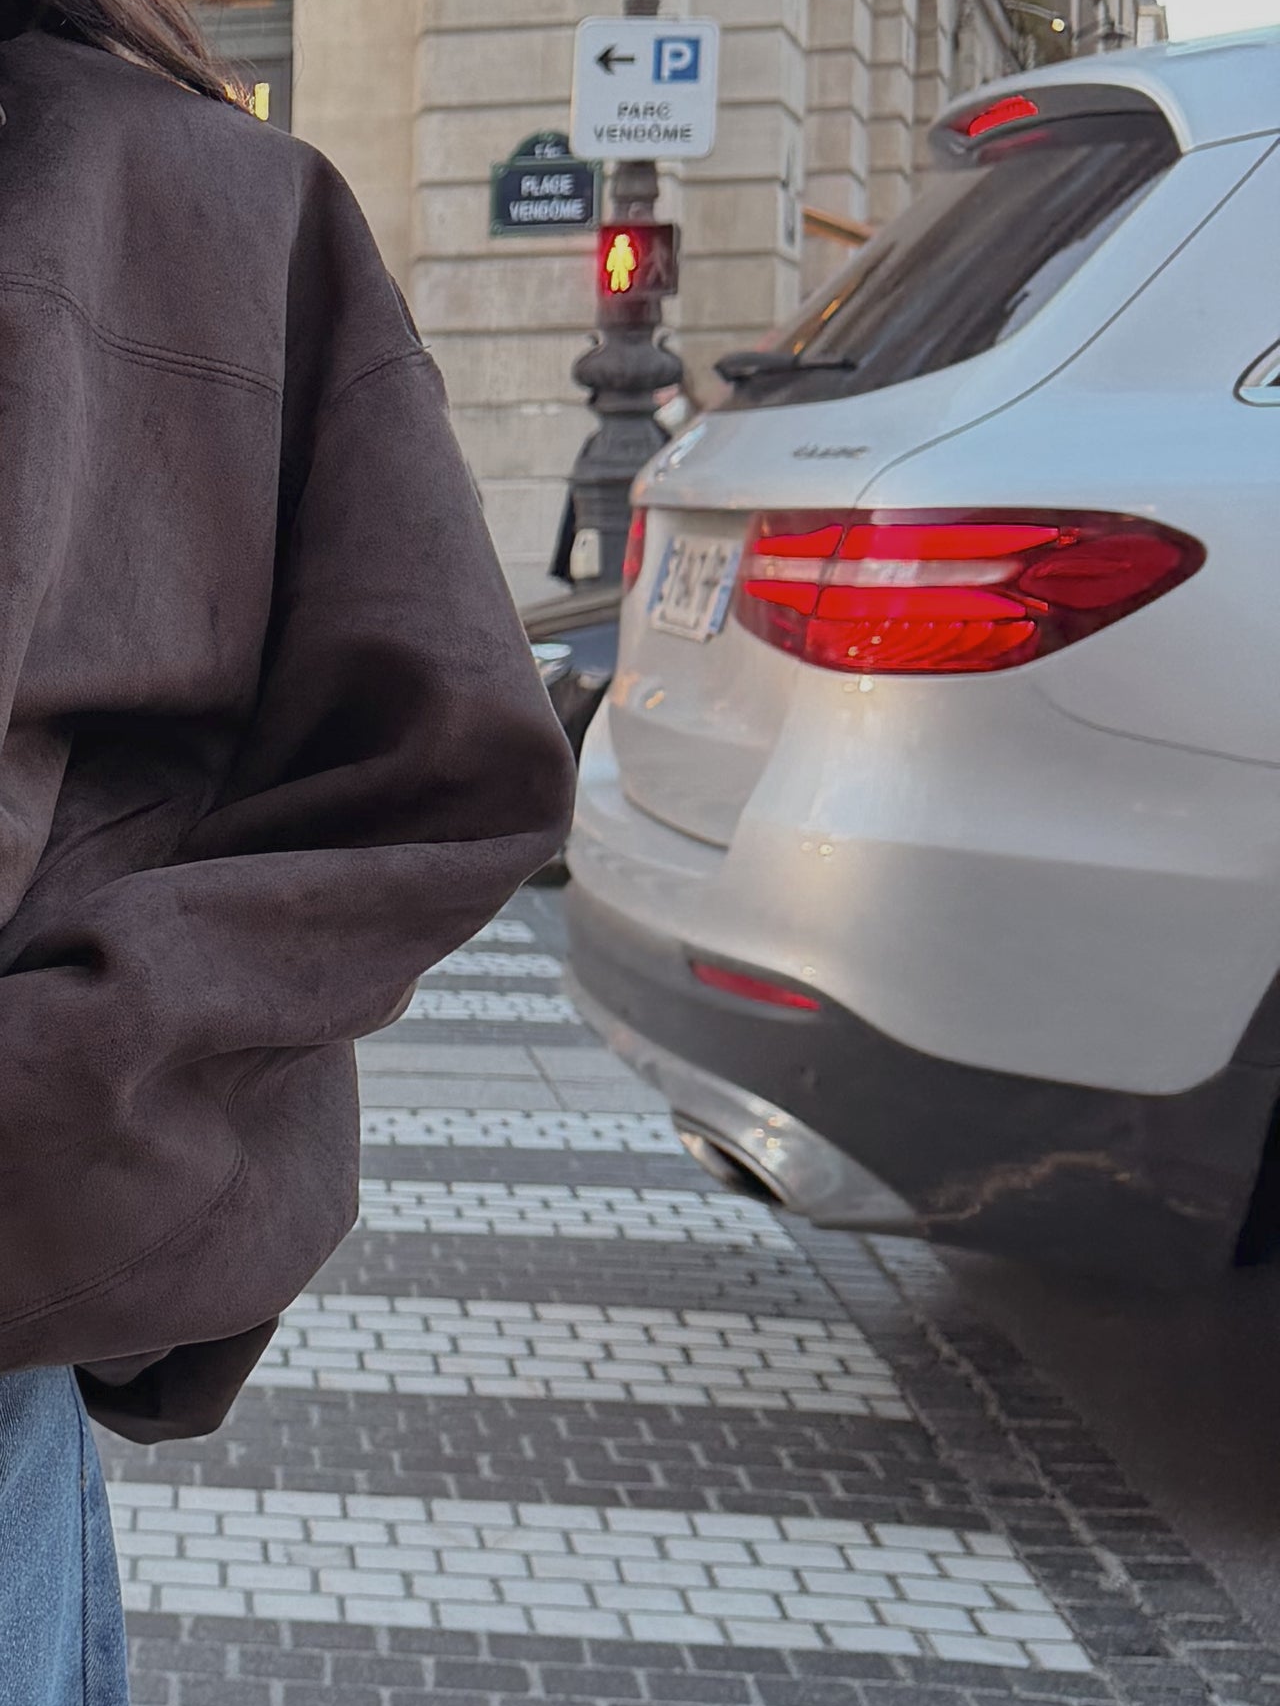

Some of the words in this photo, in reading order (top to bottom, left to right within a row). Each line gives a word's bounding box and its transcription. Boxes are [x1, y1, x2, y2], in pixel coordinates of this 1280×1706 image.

[660, 42, 691, 80] P
[617, 101, 671, 119] PARC
[520, 174, 575, 197] PLACE
[509, 196, 586, 222] VENDÔME
